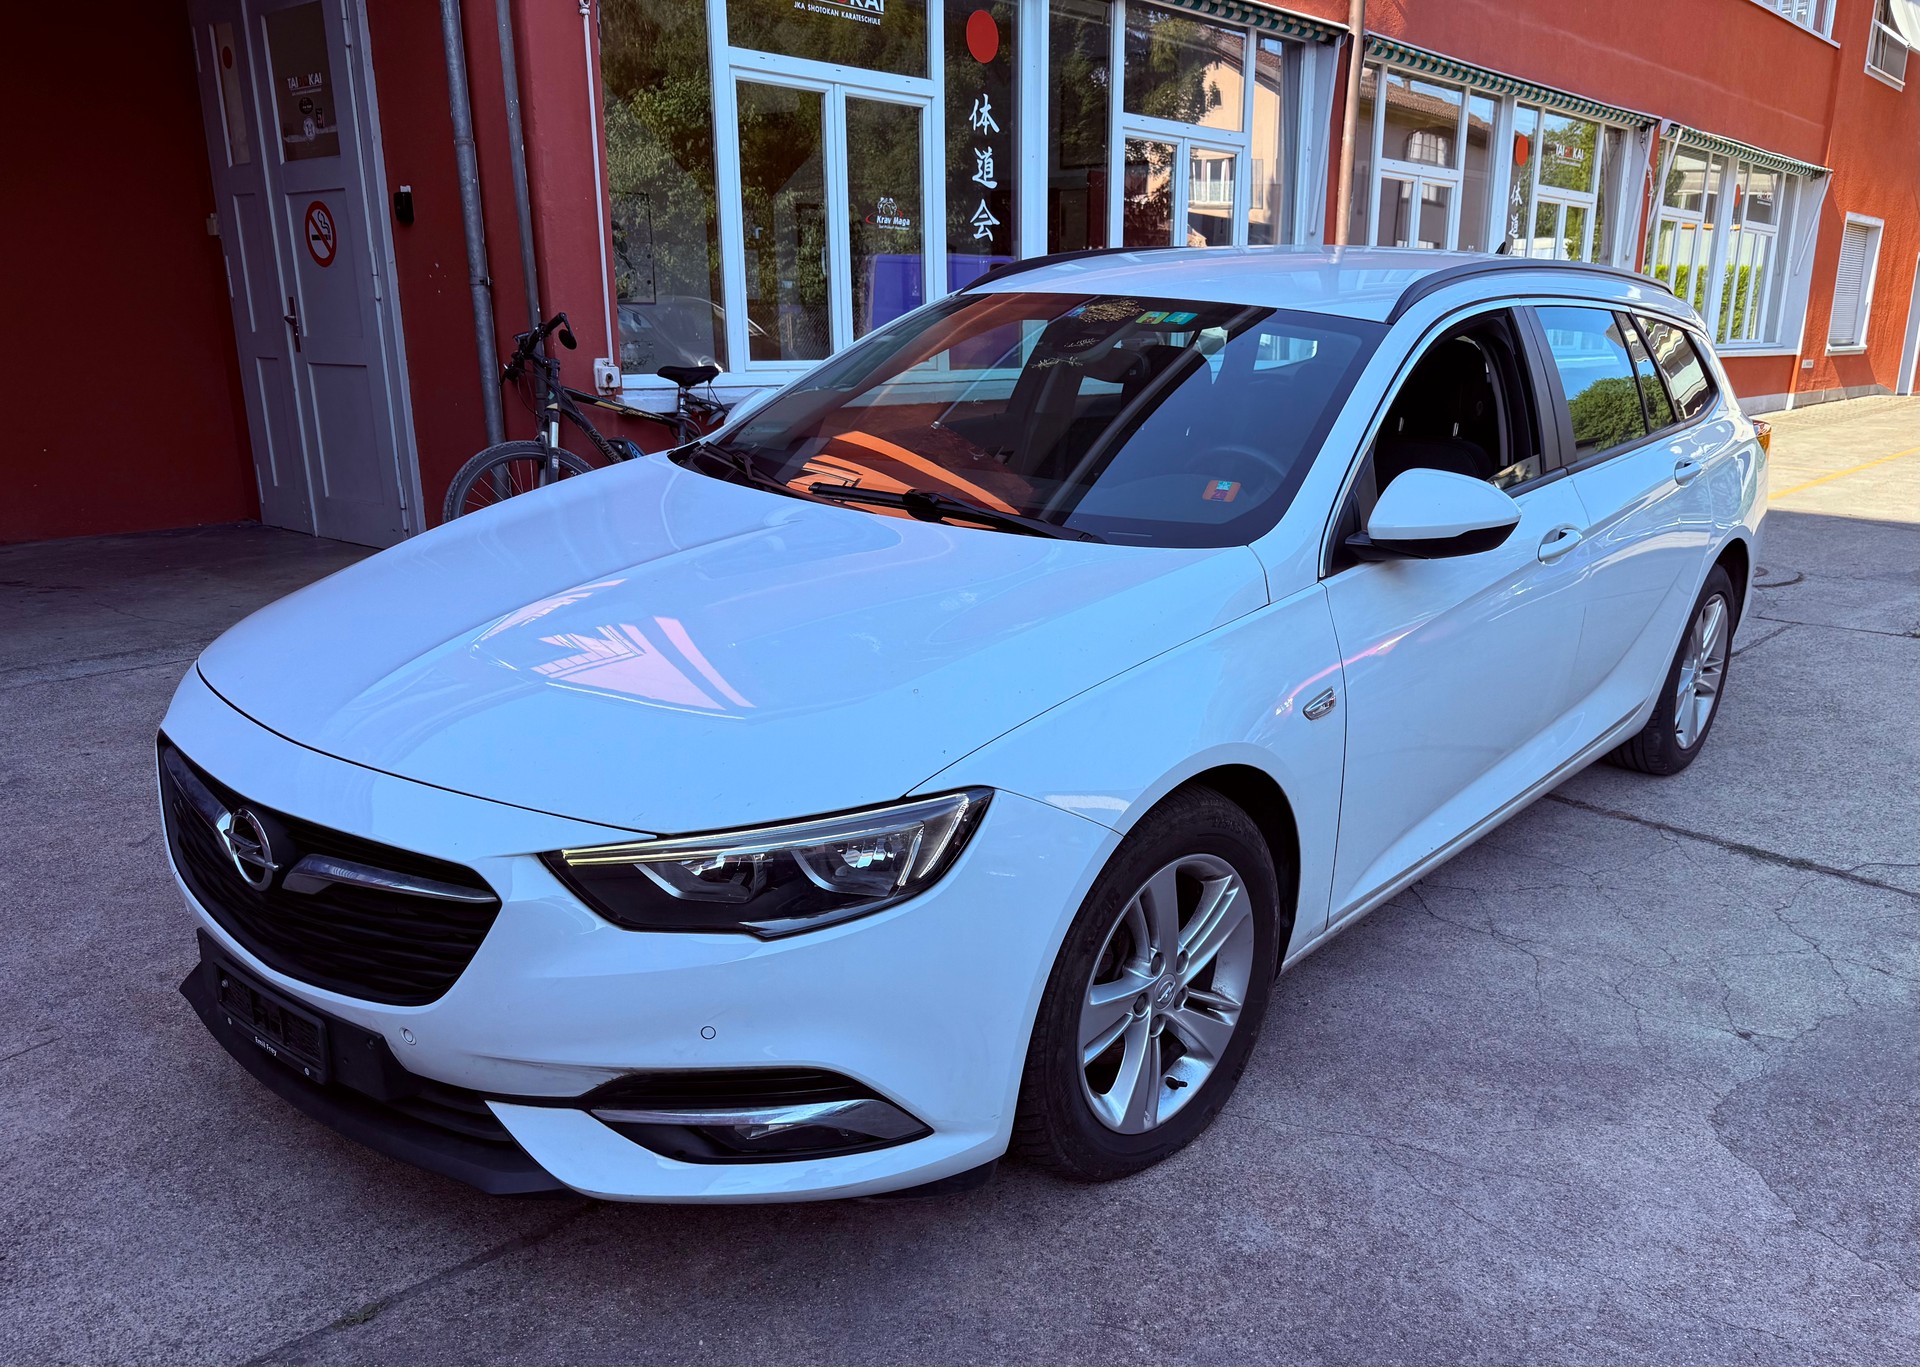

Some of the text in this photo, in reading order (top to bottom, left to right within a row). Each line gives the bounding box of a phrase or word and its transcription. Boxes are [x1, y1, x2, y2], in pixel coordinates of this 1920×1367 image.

[794, 1, 805, 10] JKA
[808, 4, 839, 17] SHOTOKAN
[841, 11, 881, 26] KARATESCHULE
[287, 72, 323, 89] TAIKAI
[1555, 143, 1584, 160] TAIKAI
[969, 93, 1000, 242] 体道会
[876, 215, 910, 227] Krav Maga
[266, 1043, 277, 1057] Frey
